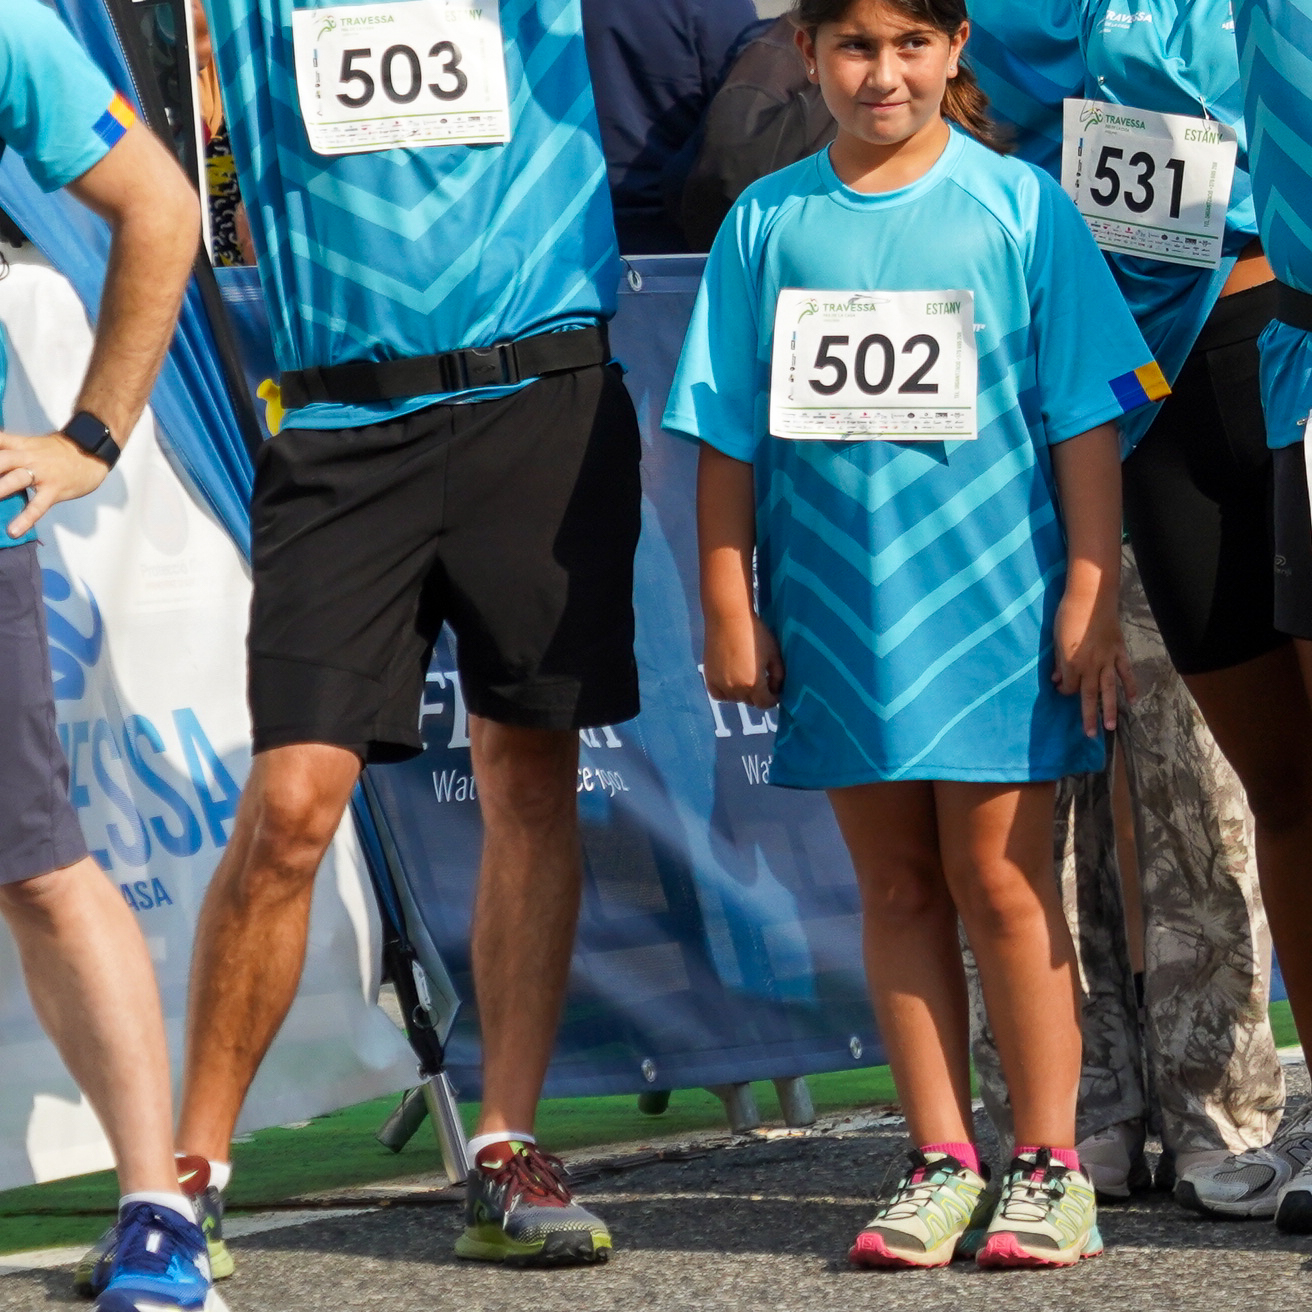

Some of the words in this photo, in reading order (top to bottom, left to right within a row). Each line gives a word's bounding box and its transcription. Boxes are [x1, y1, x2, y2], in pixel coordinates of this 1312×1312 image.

[340, 14, 395, 27] TRAVESSA
[335, 40, 468, 109] 503
[1105, 114, 1146, 130] TRAVESSA
[1184, 128, 1224, 145] ESTANY
[1090, 145, 1185, 219] 531
[823, 302, 876, 313] TRAVESSA
[926, 301, 961, 316] ESTANY
[808, 333, 940, 396] 502
